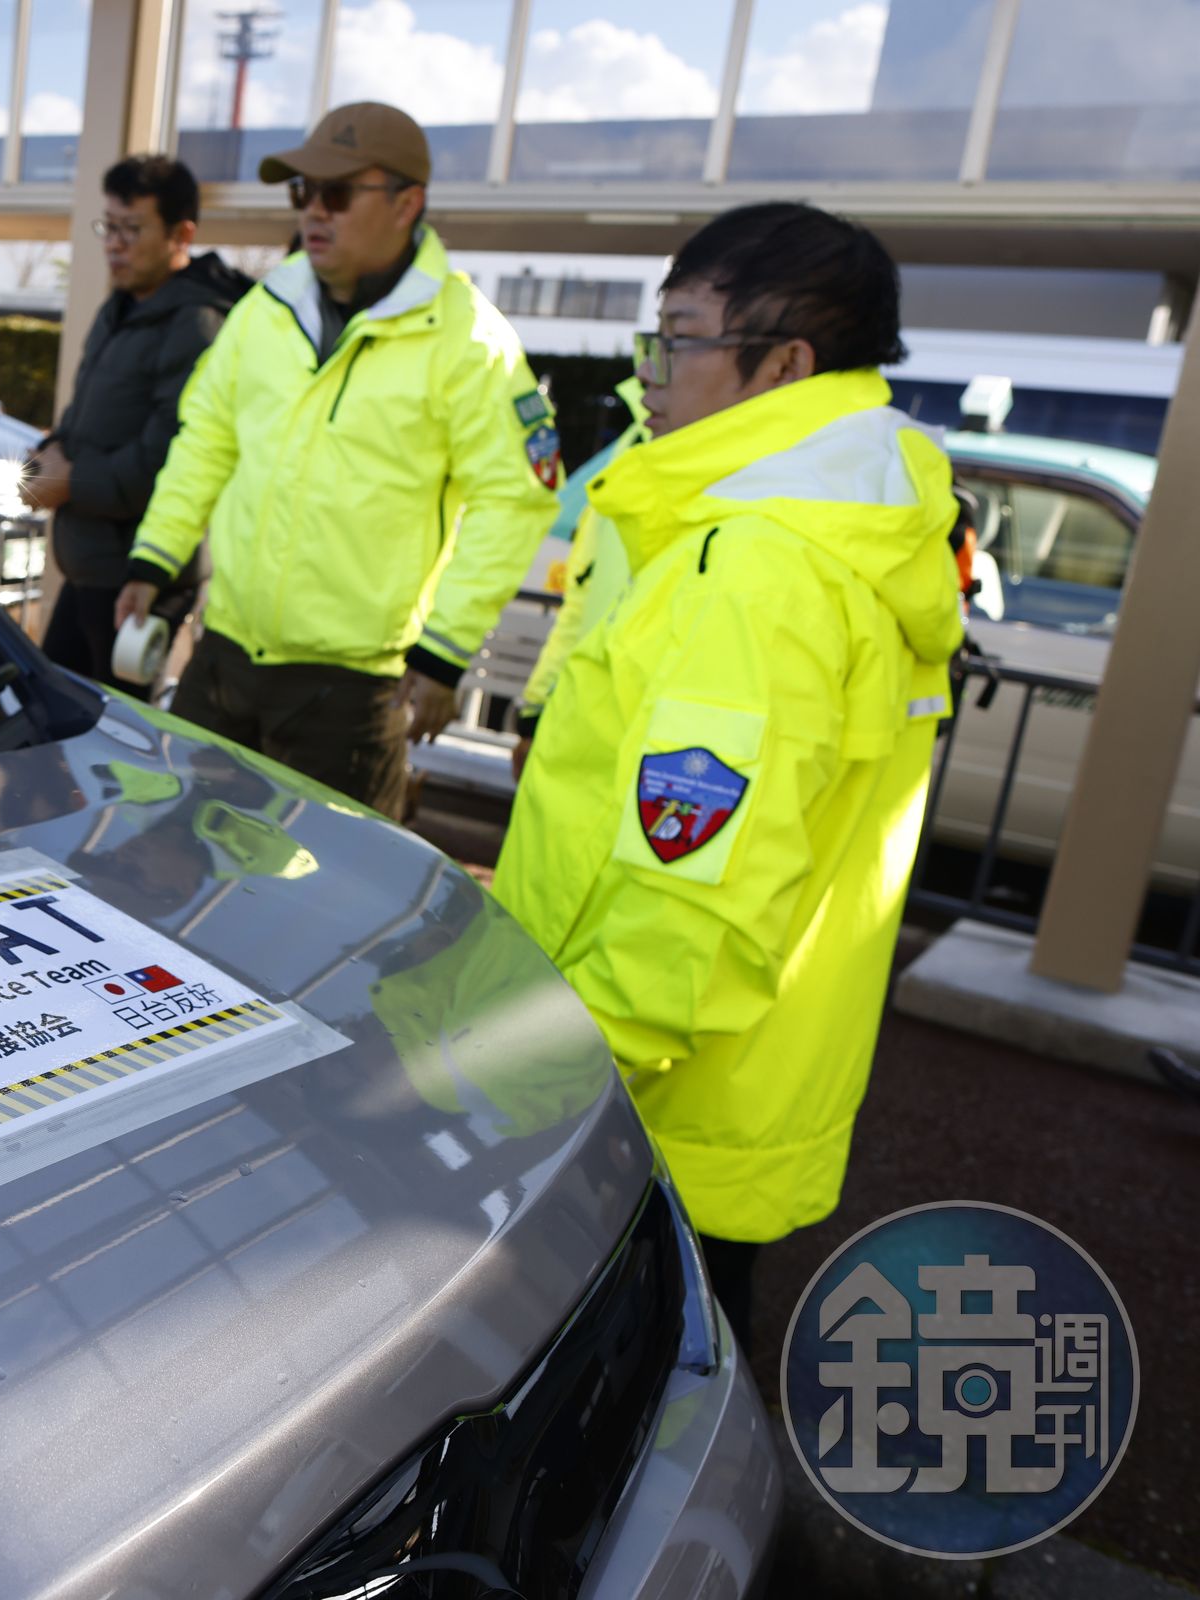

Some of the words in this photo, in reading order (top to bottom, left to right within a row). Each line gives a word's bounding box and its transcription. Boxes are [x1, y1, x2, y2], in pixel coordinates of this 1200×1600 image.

[21, 960, 111, 988] Team
[113, 983, 222, 1030] 日台友好
